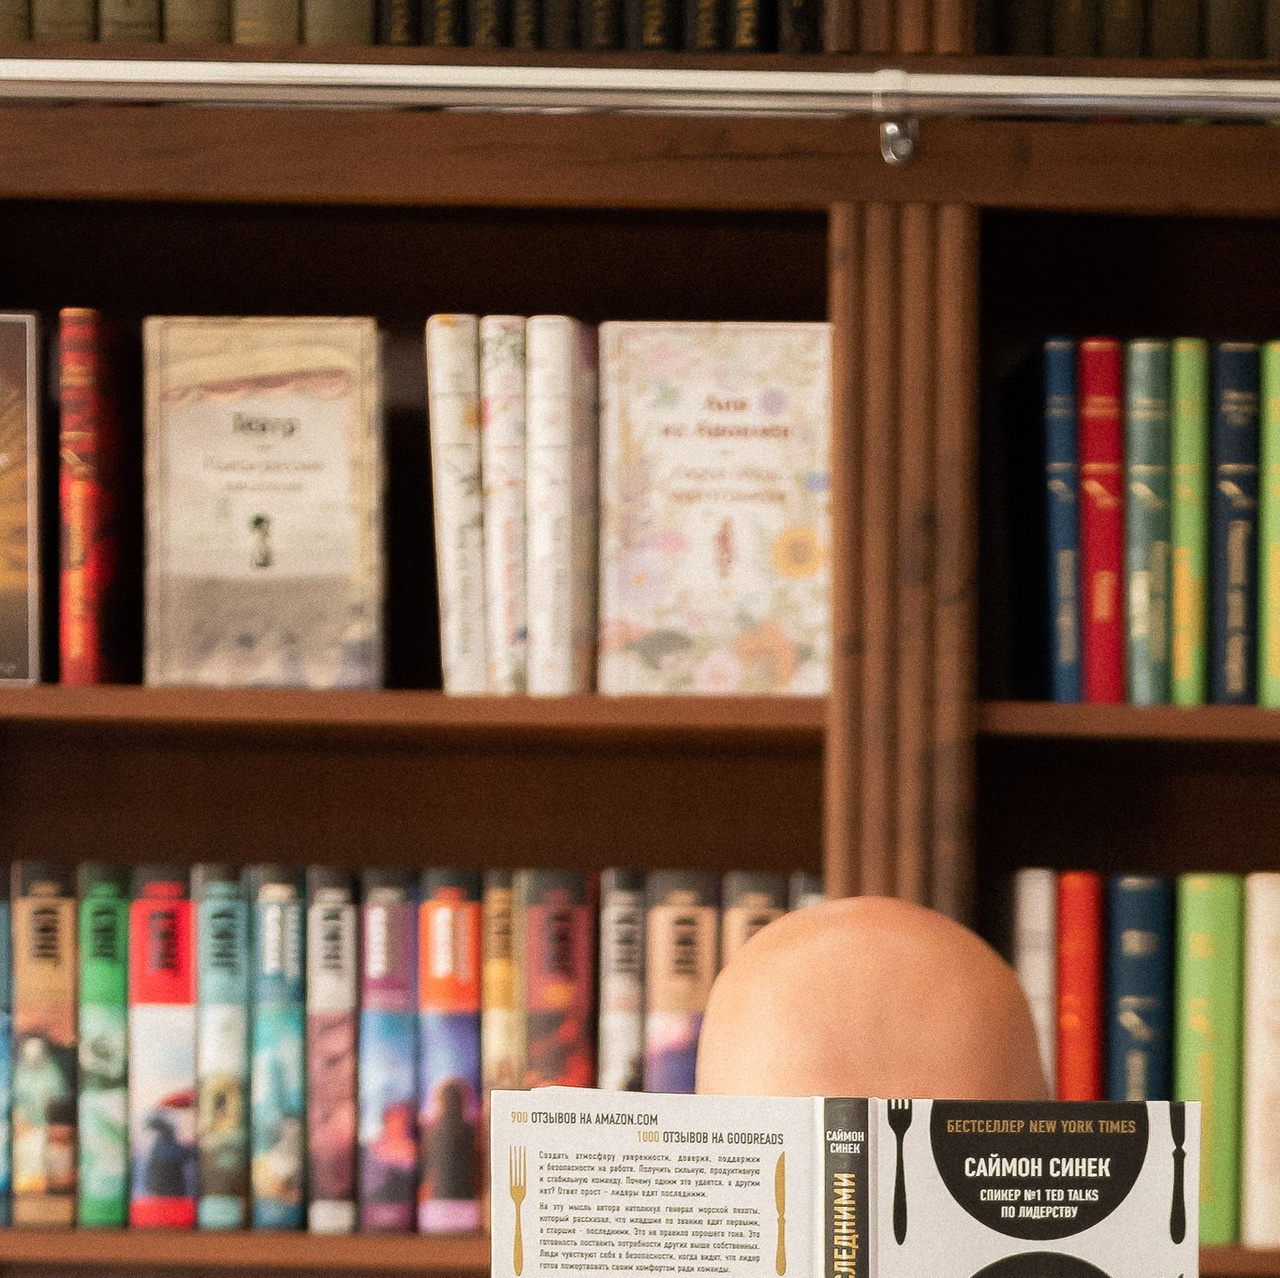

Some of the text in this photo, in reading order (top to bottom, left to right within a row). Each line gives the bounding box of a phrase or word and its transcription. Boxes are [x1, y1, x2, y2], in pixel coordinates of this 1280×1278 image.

[511, 1111, 659, 1125] 900 ОТЗЫВОВ НА AMAZON.COM
[947, 1119, 1136, 1133] БЕСТСЕЛЛЕР NEW YORK TIMES
[638, 1130, 784, 1144] 1000 ОТЗЫВОВ НА GOODREADS
[826, 1129, 865, 1143] САЙМОН
[829, 1142, 861, 1155] СИНЕК
[964, 1154, 1111, 1178] САЙМОН СИНЕК
[980, 1189, 1099, 1202] СПИКЕР №1 TED TALKS
[1001, 1205, 1078, 1219] ПО ЛИДЕРСТВУ
